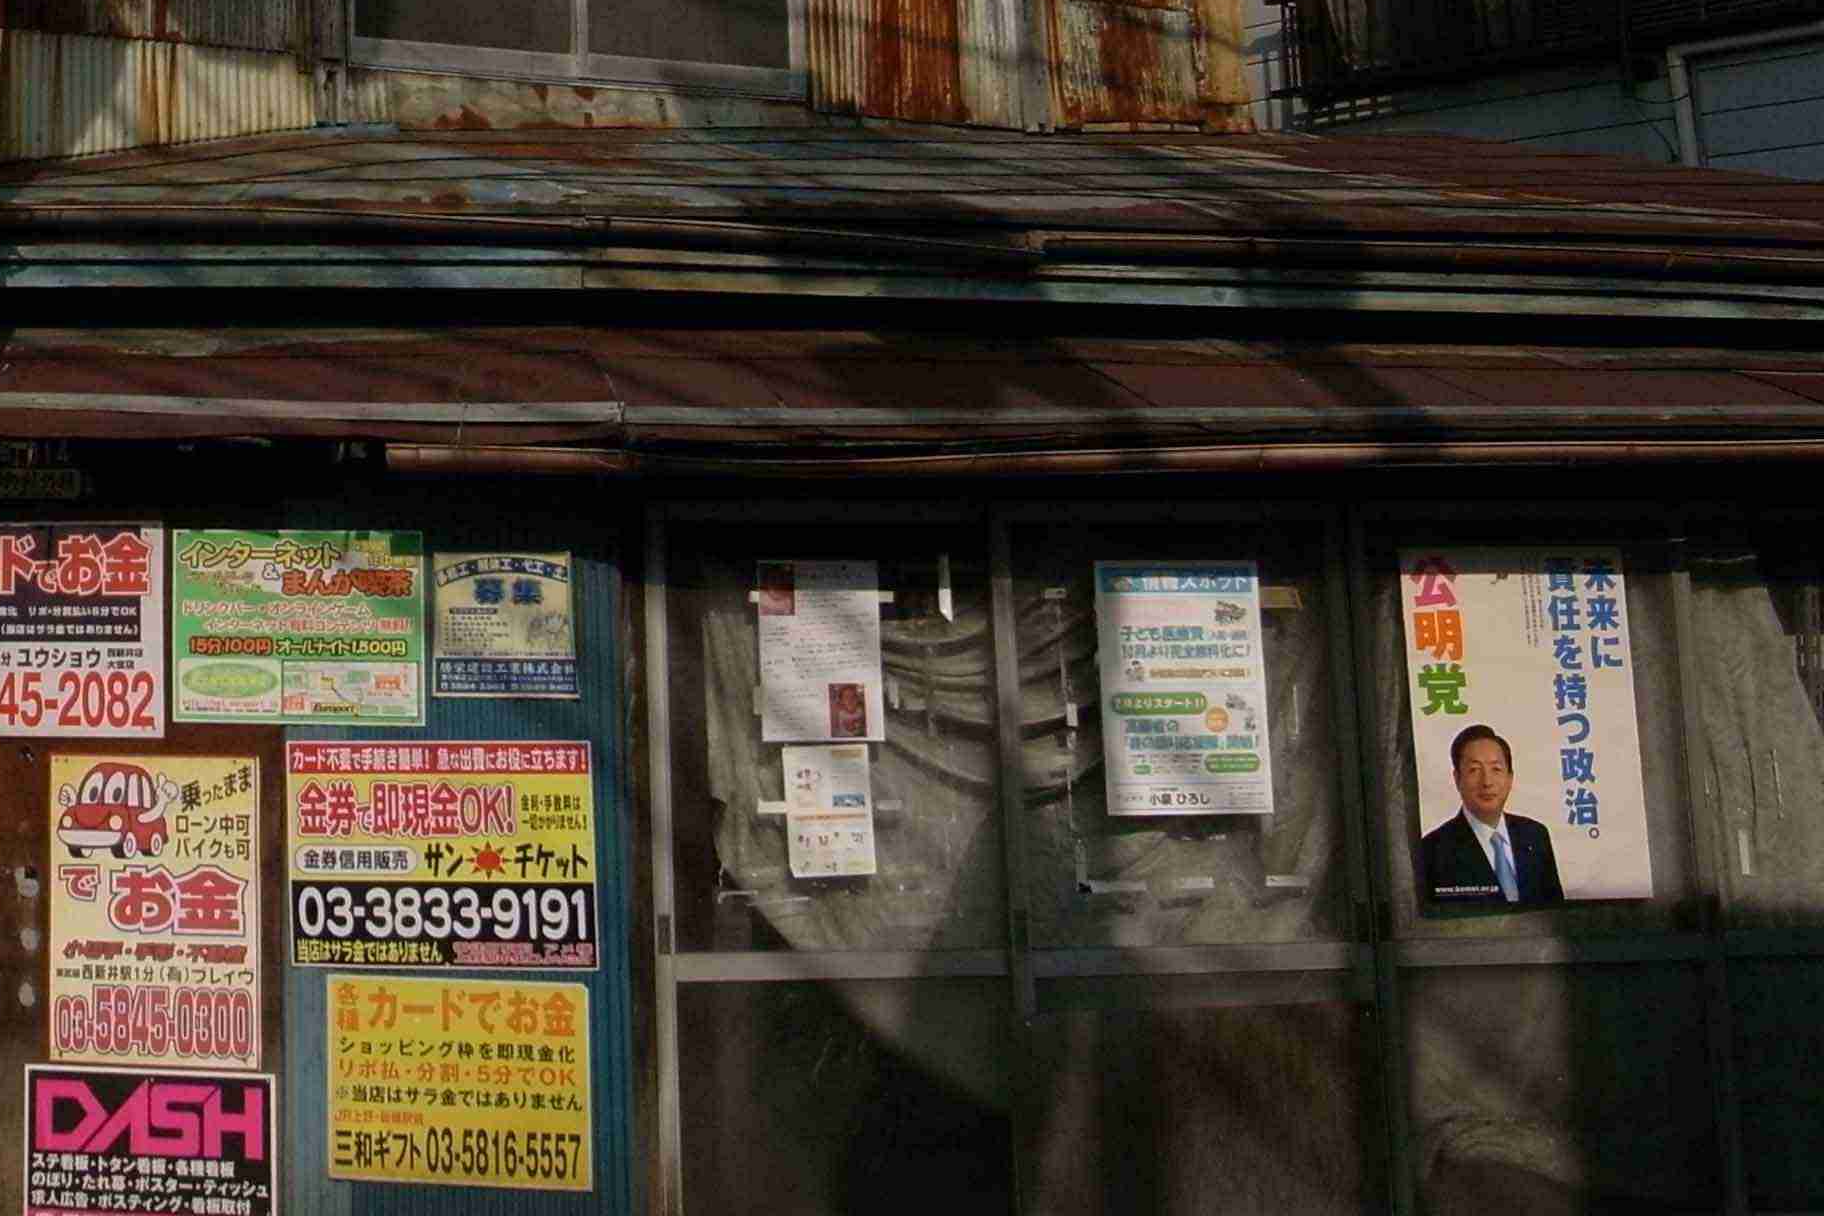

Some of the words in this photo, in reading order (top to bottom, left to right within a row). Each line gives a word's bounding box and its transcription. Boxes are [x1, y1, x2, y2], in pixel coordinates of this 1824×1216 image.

[179, 539, 342, 572] インターネット
[1584, 558, 1624, 668] 未来に
[16, 647, 102, 669] ユウショウ
[1411, 557, 1468, 715] 公明党
[182, 766, 253, 813] 乗ったまま
[296, 782, 515, 837] 金券で即現金OK!
[176, 814, 251, 836] ローン中可
[176, 839, 251, 861] バイクも可
[303, 848, 408, 871] 金券信用販売
[514, 843, 588, 878] チケット
[297, 885, 588, 940] 03-3833-9191
[367, 988, 577, 1037] カードでお金
[338, 1036, 576, 1064] ショッピング枠を即現金化
[36, 1078, 265, 1160] DASH
[335, 1128, 422, 1172] 三和ギフト
